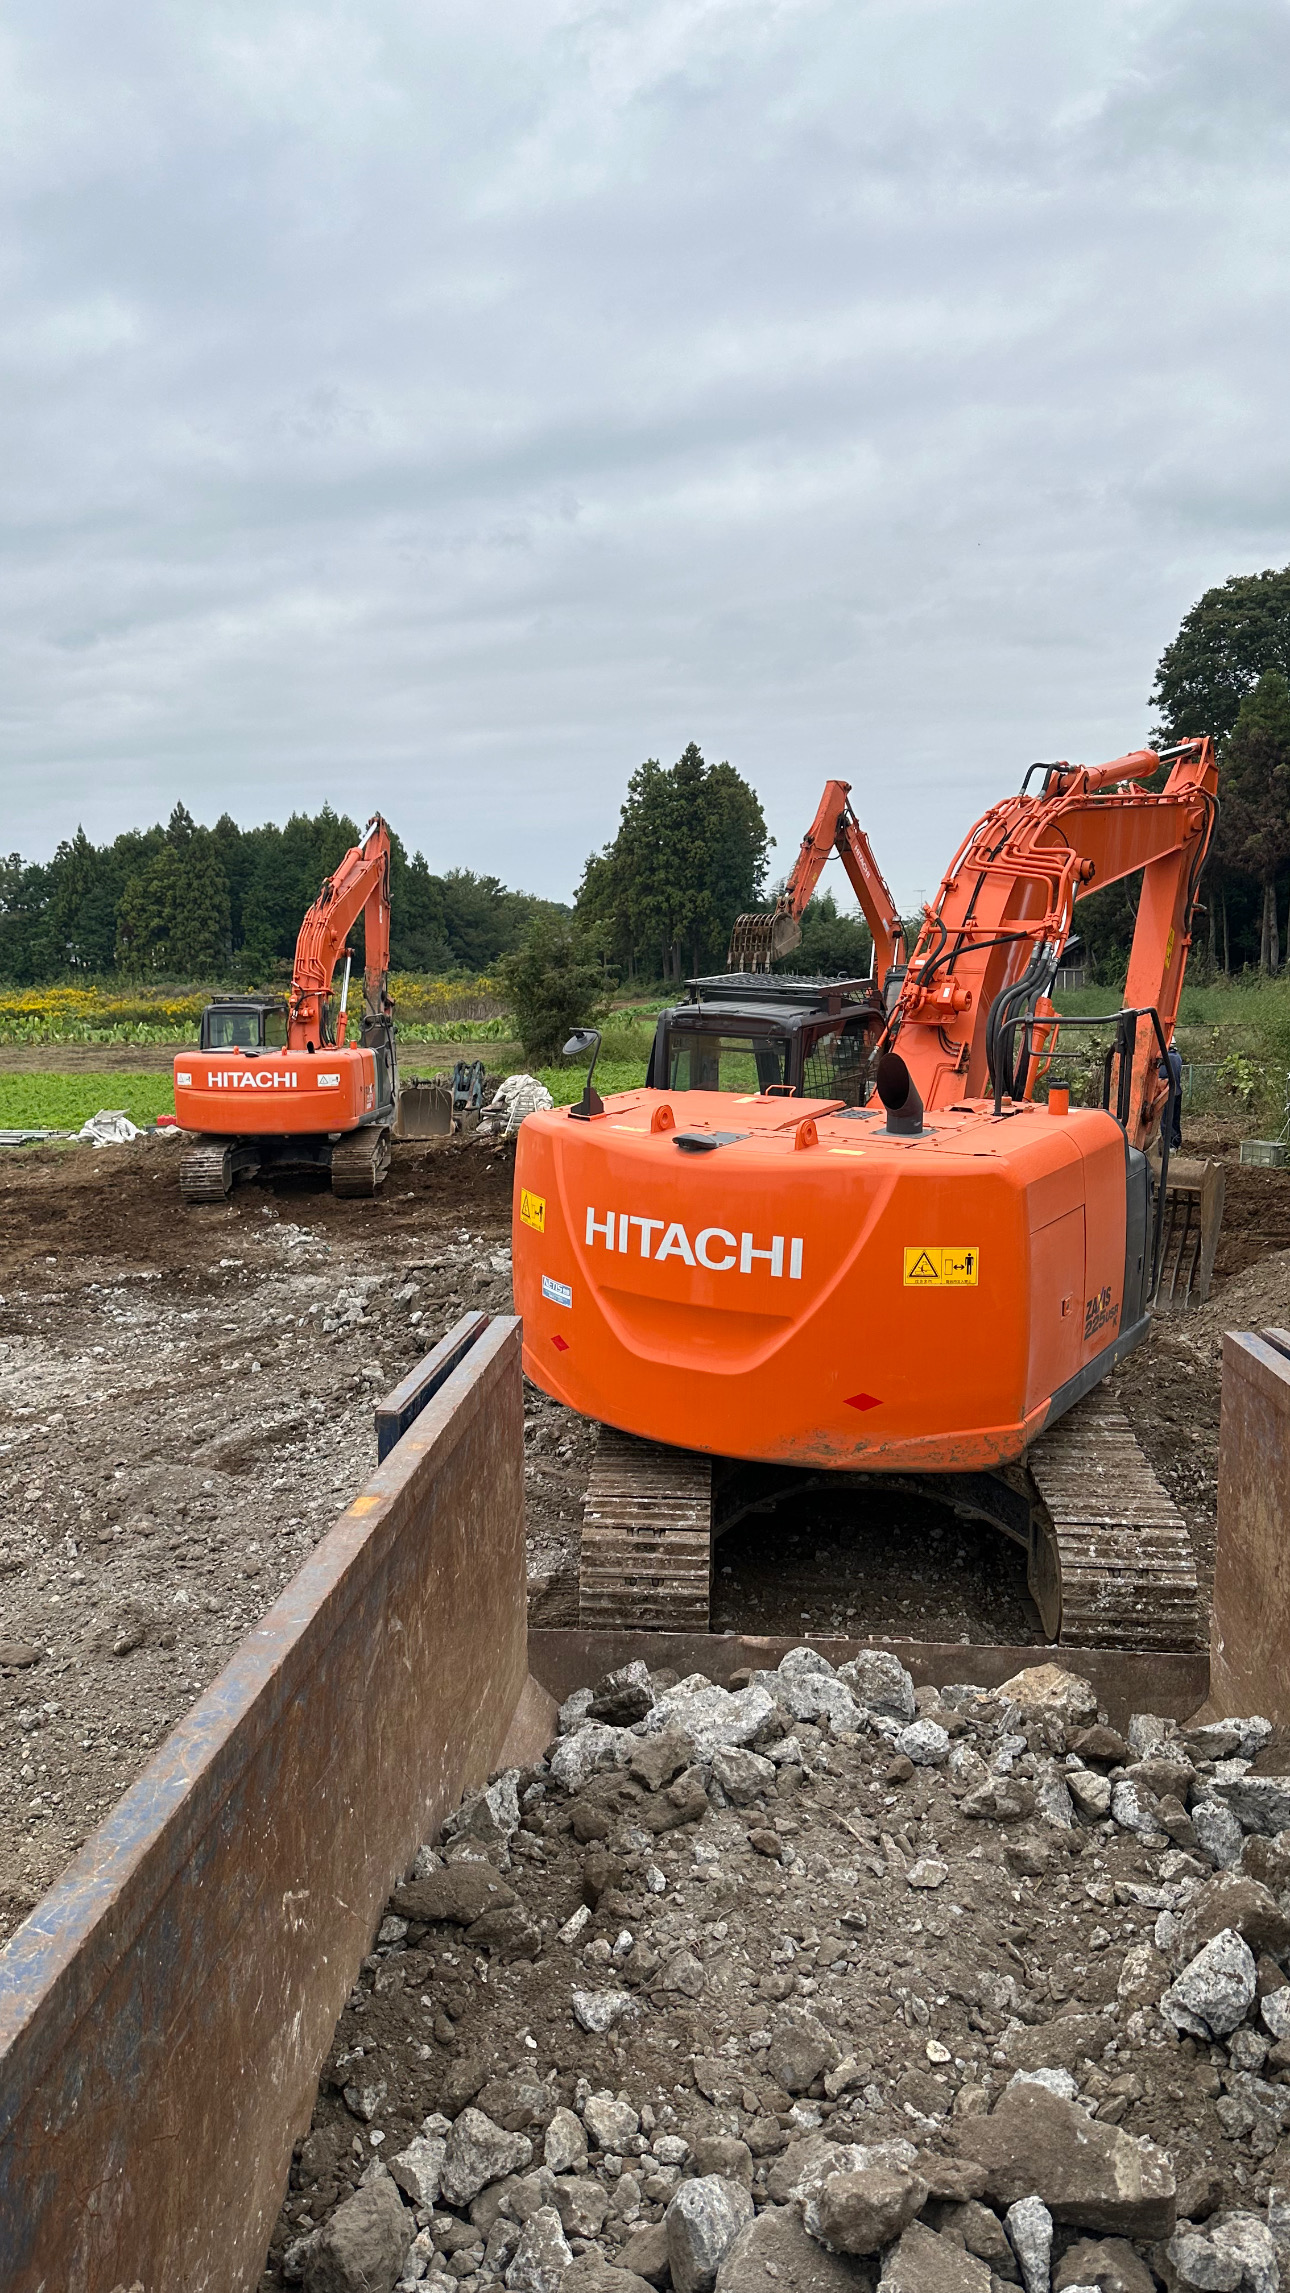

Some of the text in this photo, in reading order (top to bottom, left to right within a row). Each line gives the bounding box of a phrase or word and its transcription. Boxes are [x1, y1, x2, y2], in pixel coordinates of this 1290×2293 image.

[853, 844, 871, 879] HITACHI
[208, 1071, 298, 1088] HITACHI
[585, 1206, 804, 1280] HITACHI
[1085, 1286, 1112, 1322] ZAXIS
